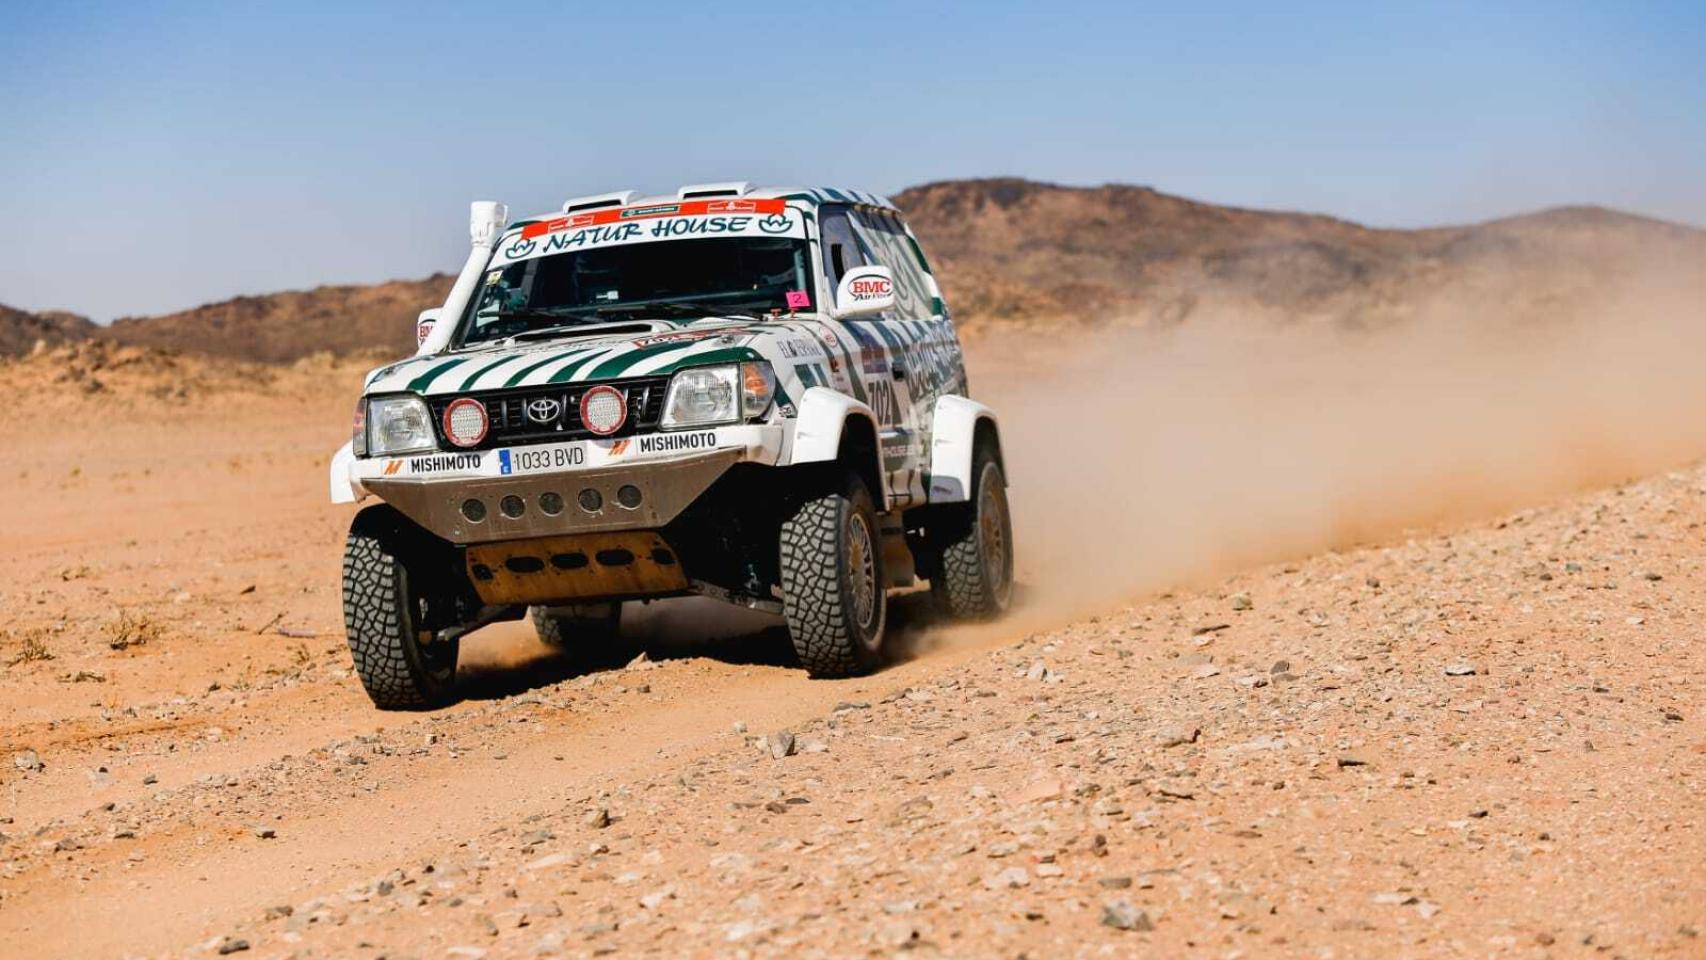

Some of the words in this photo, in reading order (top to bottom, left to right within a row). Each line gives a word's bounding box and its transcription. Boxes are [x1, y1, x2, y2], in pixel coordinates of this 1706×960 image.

[543, 223, 642, 253] NATUR
[651, 216, 753, 238] HOUSE
[852, 280, 891, 293] BMC
[792, 293, 805, 304] 2
[640, 432, 716, 453] MISHIMOTO
[411, 454, 481, 474] MISHIMOTO
[514, 449, 551, 471] 1033
[554, 447, 584, 467] BVD
